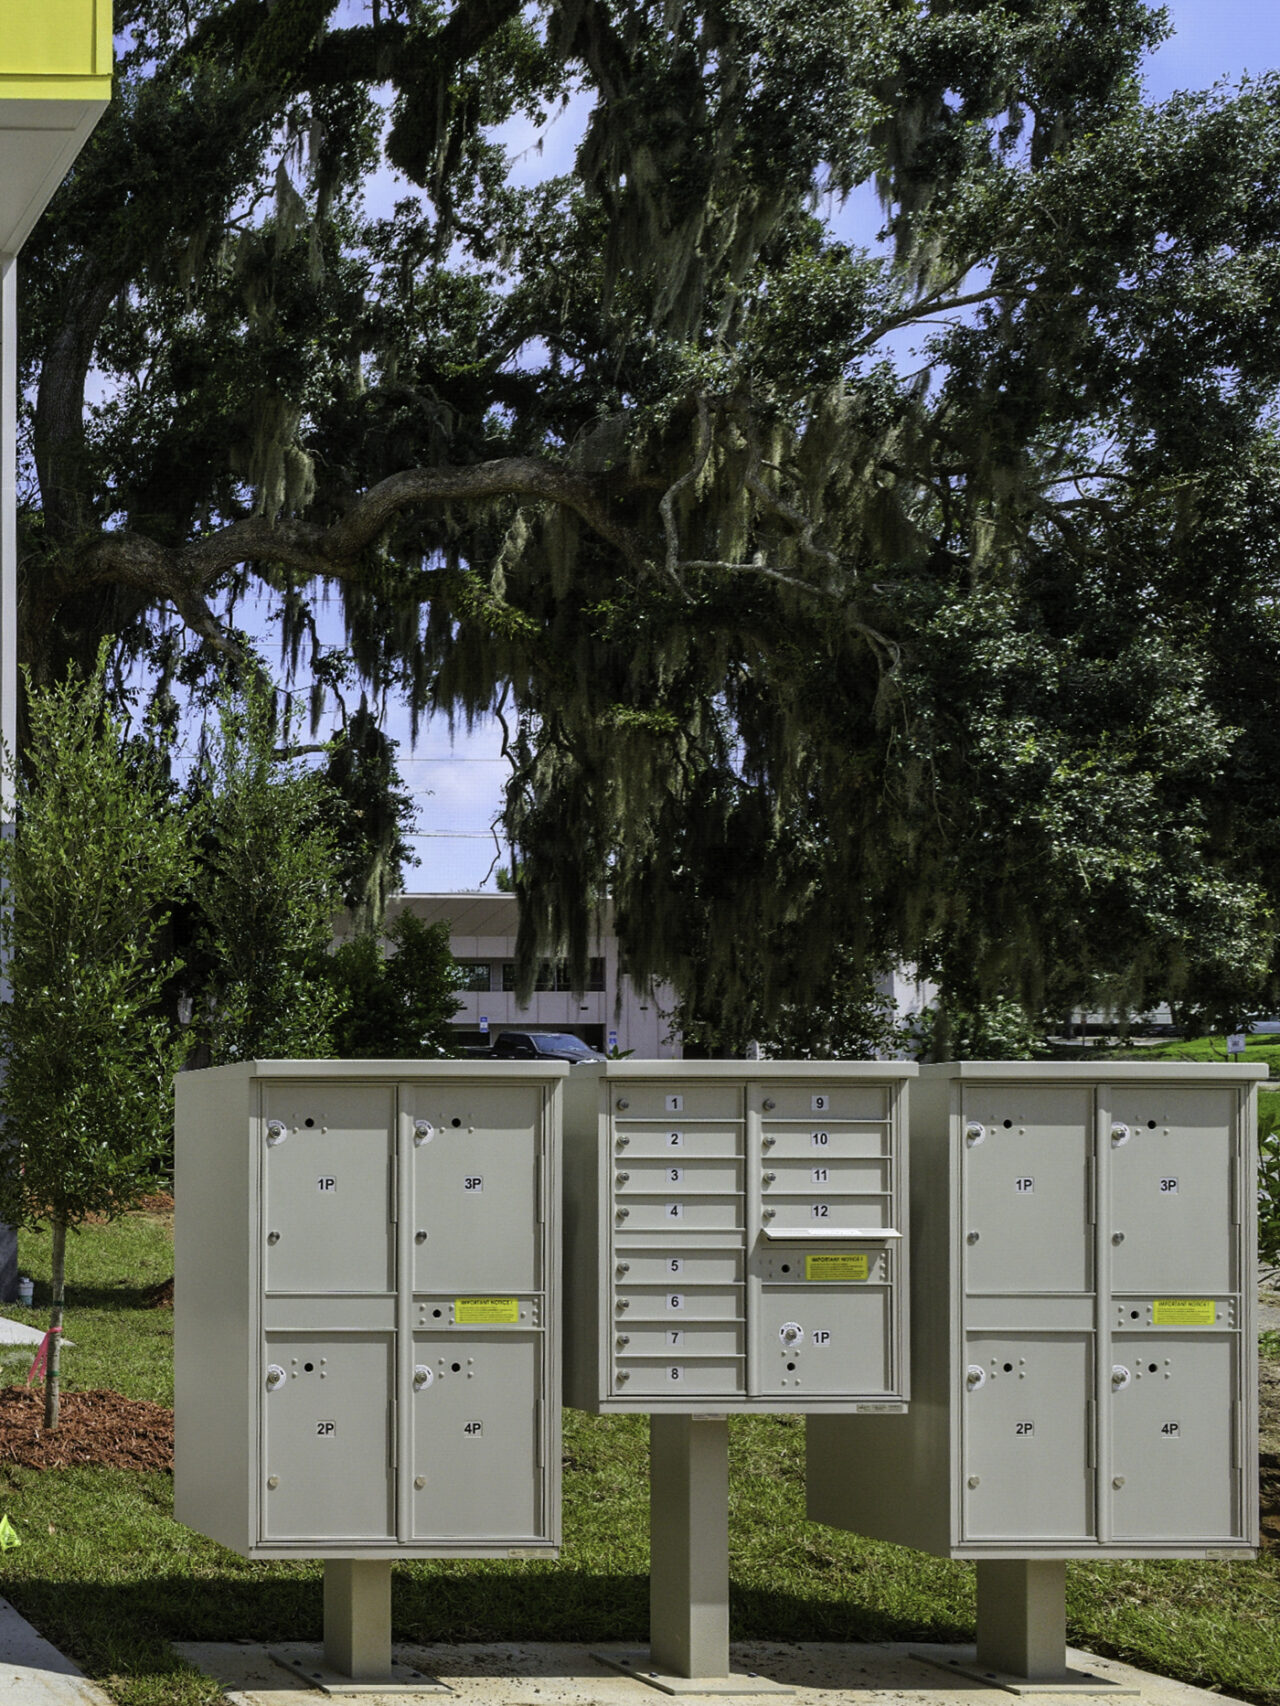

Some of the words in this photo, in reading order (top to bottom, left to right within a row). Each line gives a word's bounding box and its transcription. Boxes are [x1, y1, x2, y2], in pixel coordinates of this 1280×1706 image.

[813, 1132, 828, 1145] 10
[814, 1169, 827, 1181] 11
[318, 1178, 335, 1190] 1P
[464, 1178, 482, 1190] 3P
[1016, 1179, 1033, 1191] 1P
[1160, 1179, 1177, 1192] 3P
[813, 1205, 828, 1217] 12
[813, 1331, 830, 1344] 1P
[317, 1422, 335, 1435] 2P
[464, 1422, 482, 1434] 4P
[1016, 1423, 1033, 1435] 2P
[1161, 1423, 1179, 1435] 4P
